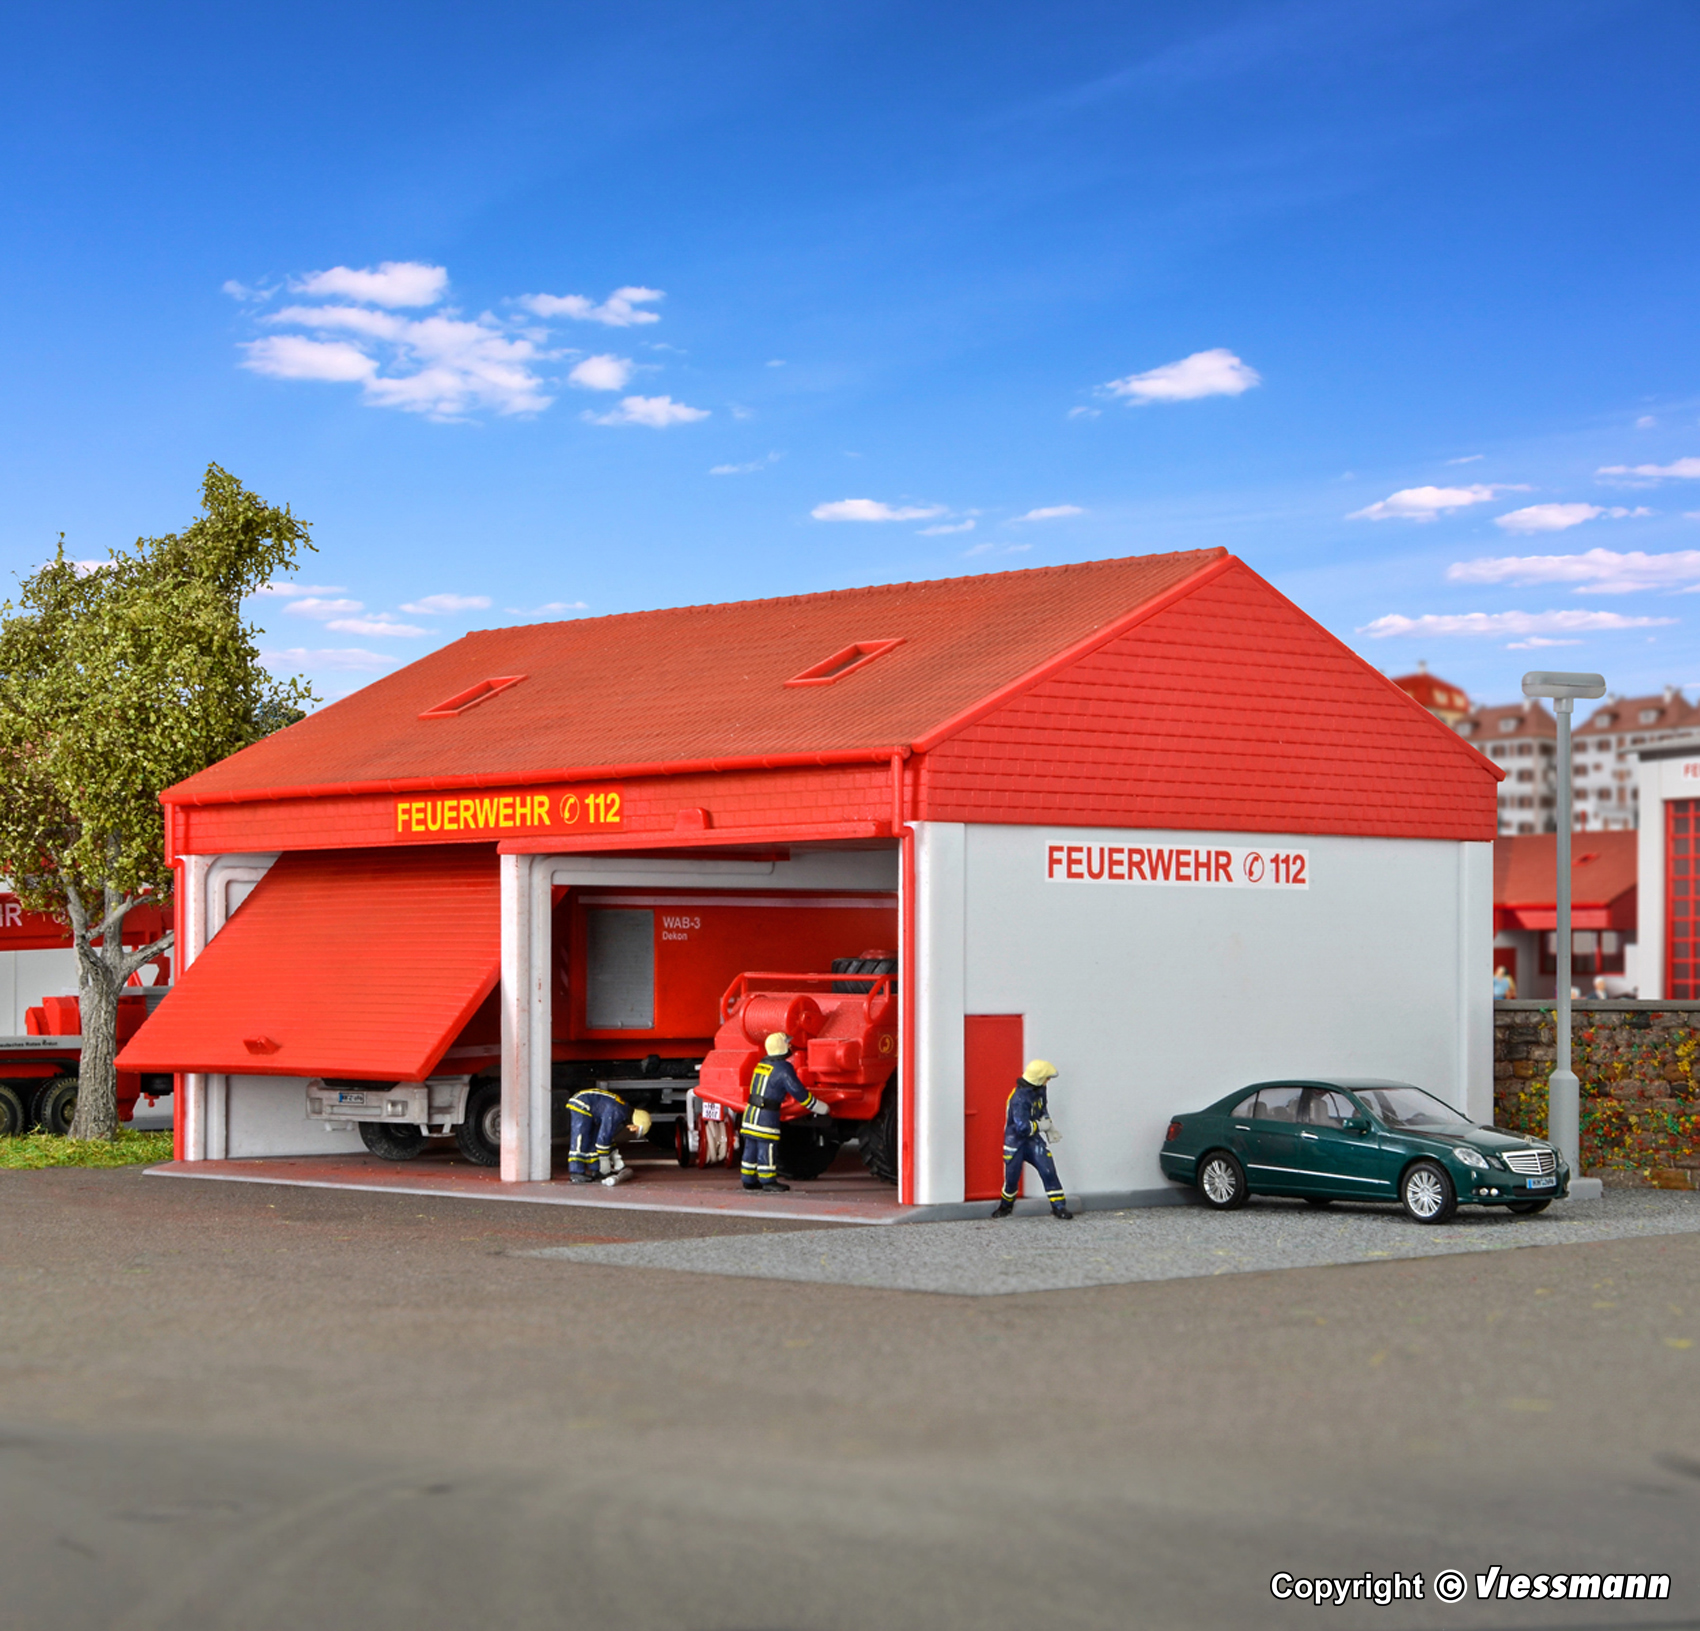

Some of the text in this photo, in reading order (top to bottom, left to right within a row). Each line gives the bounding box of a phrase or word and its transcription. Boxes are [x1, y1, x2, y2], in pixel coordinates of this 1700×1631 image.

[397, 793, 620, 832] FEUERWEHR 112
[1048, 845, 1306, 884] FEUERWEHR 112
[662, 916, 701, 929] WAB-3
[662, 931, 688, 940] Dekon
